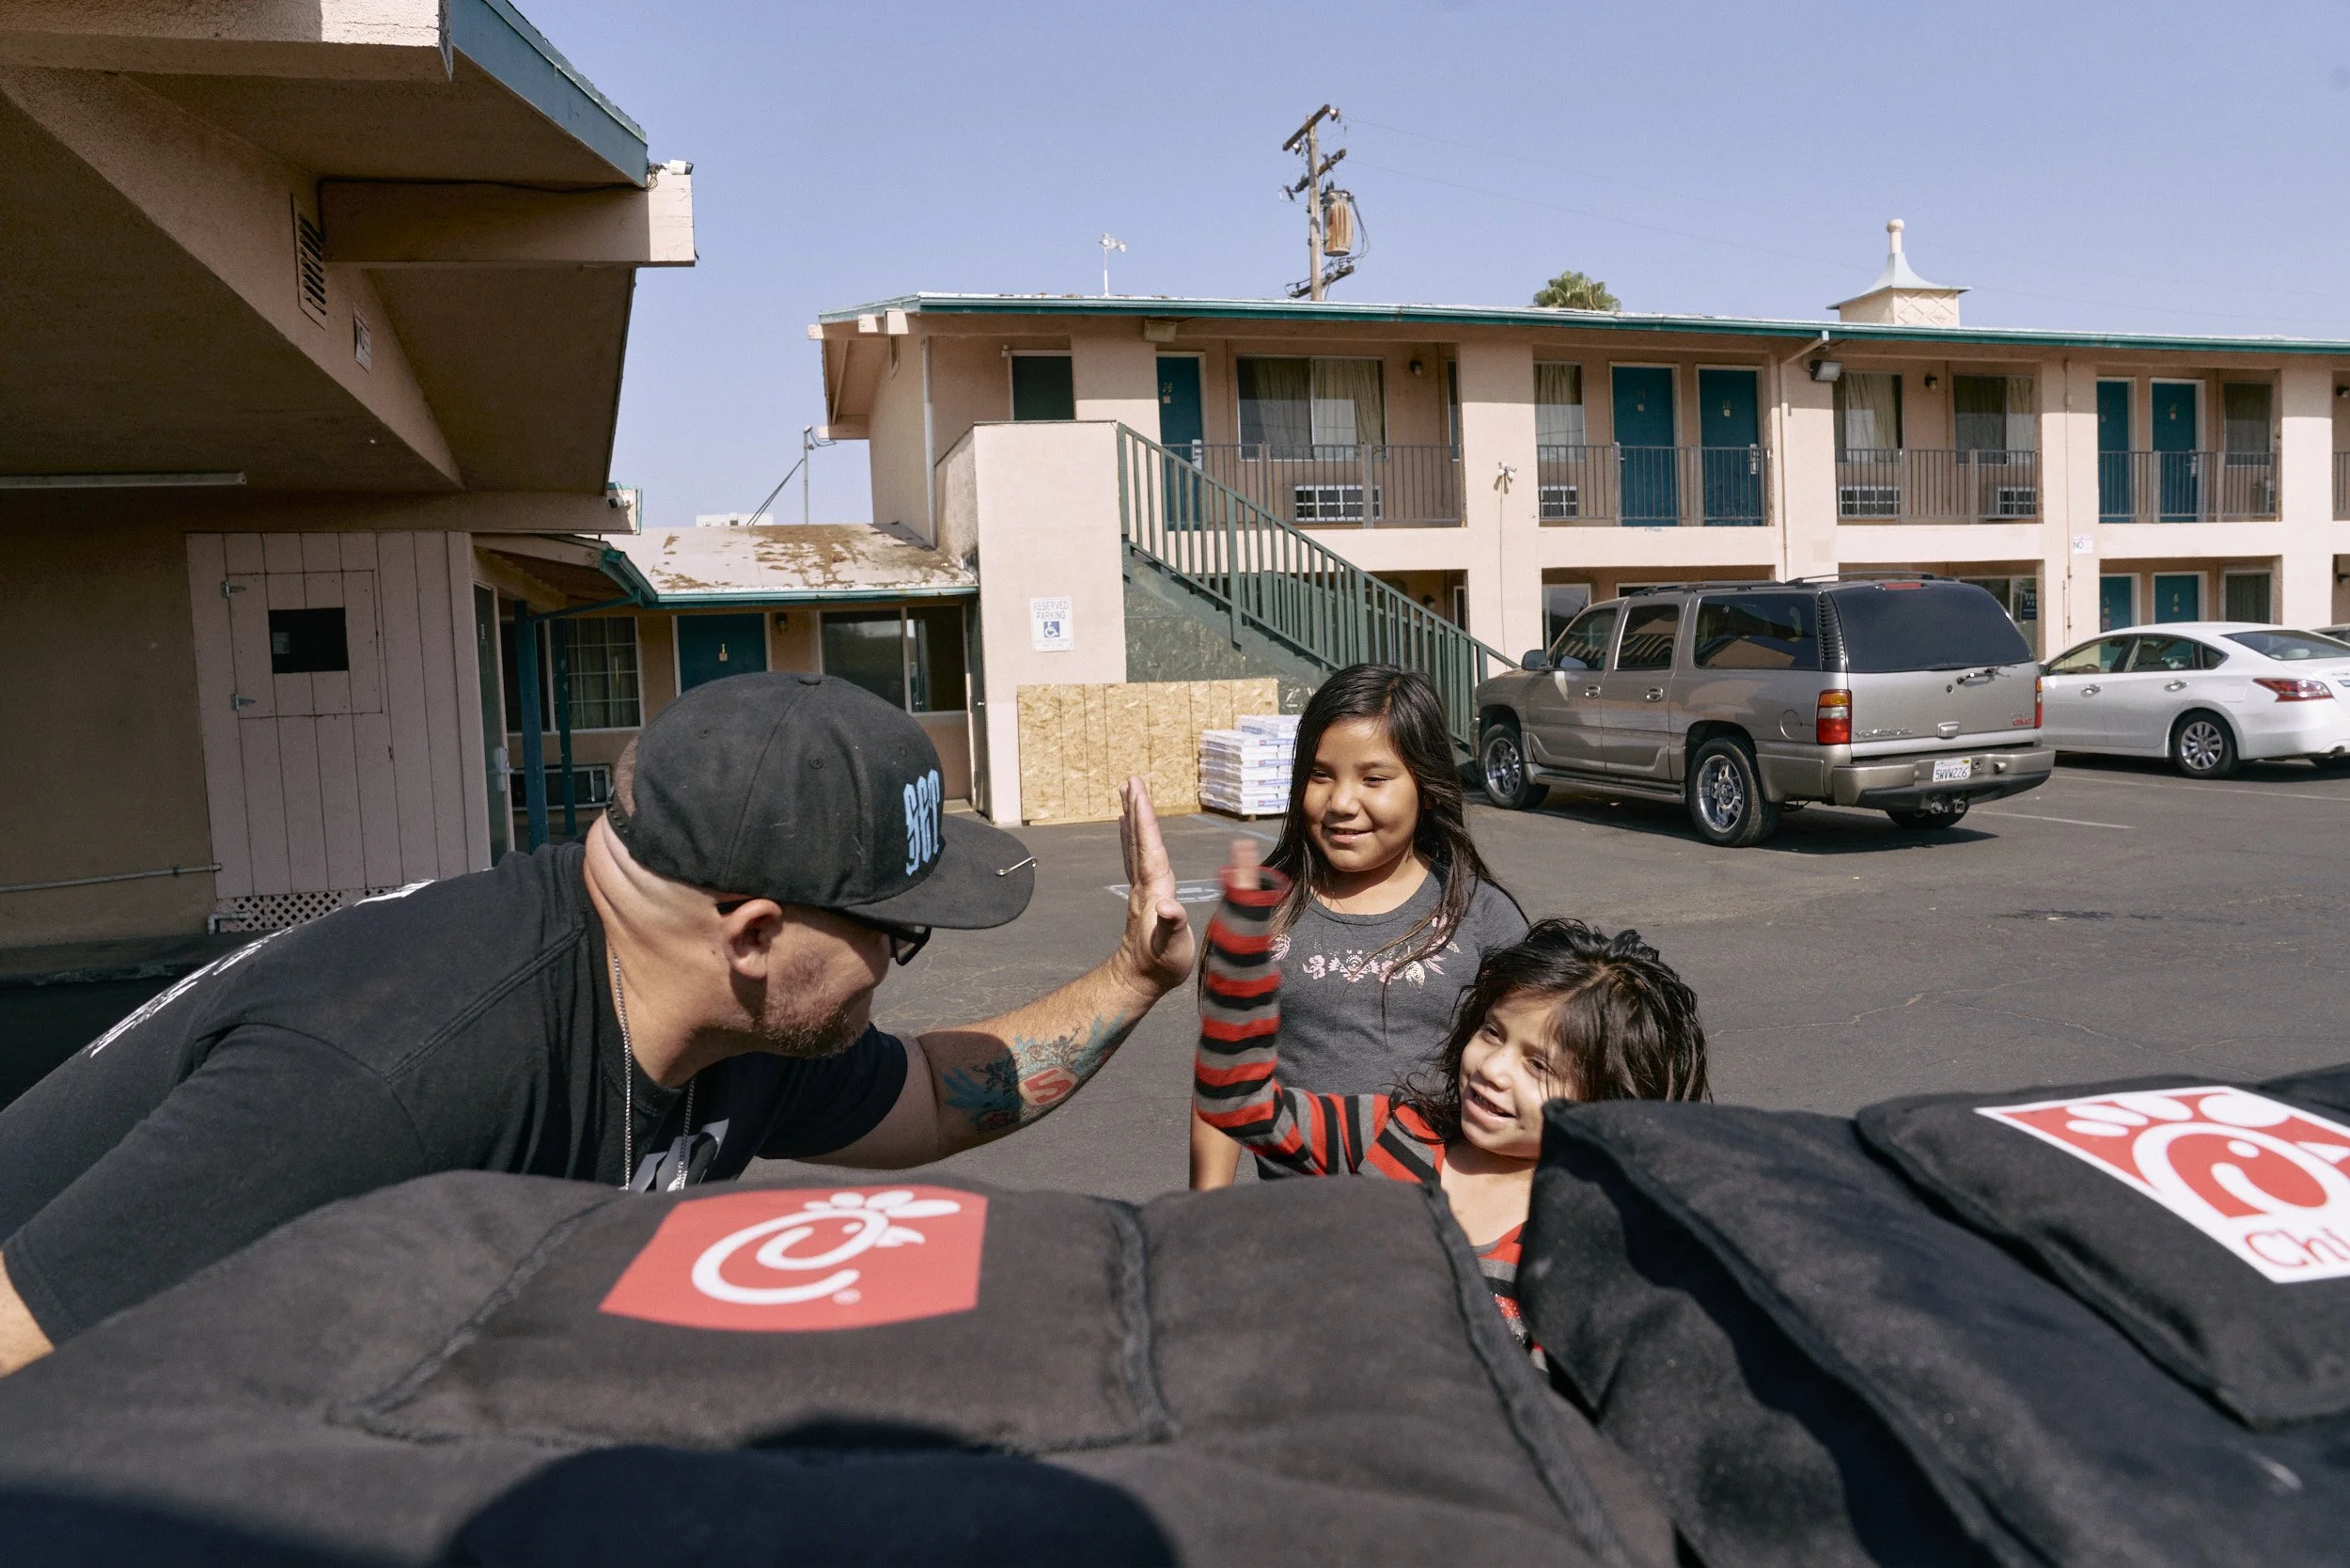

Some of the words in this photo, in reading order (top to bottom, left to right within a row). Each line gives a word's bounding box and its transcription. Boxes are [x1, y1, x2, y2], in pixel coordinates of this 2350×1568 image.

[1033, 601, 1069, 611] RESERVED
[1036, 610, 1067, 620] PARKING
[1935, 767, 1968, 780] 5WVW226
